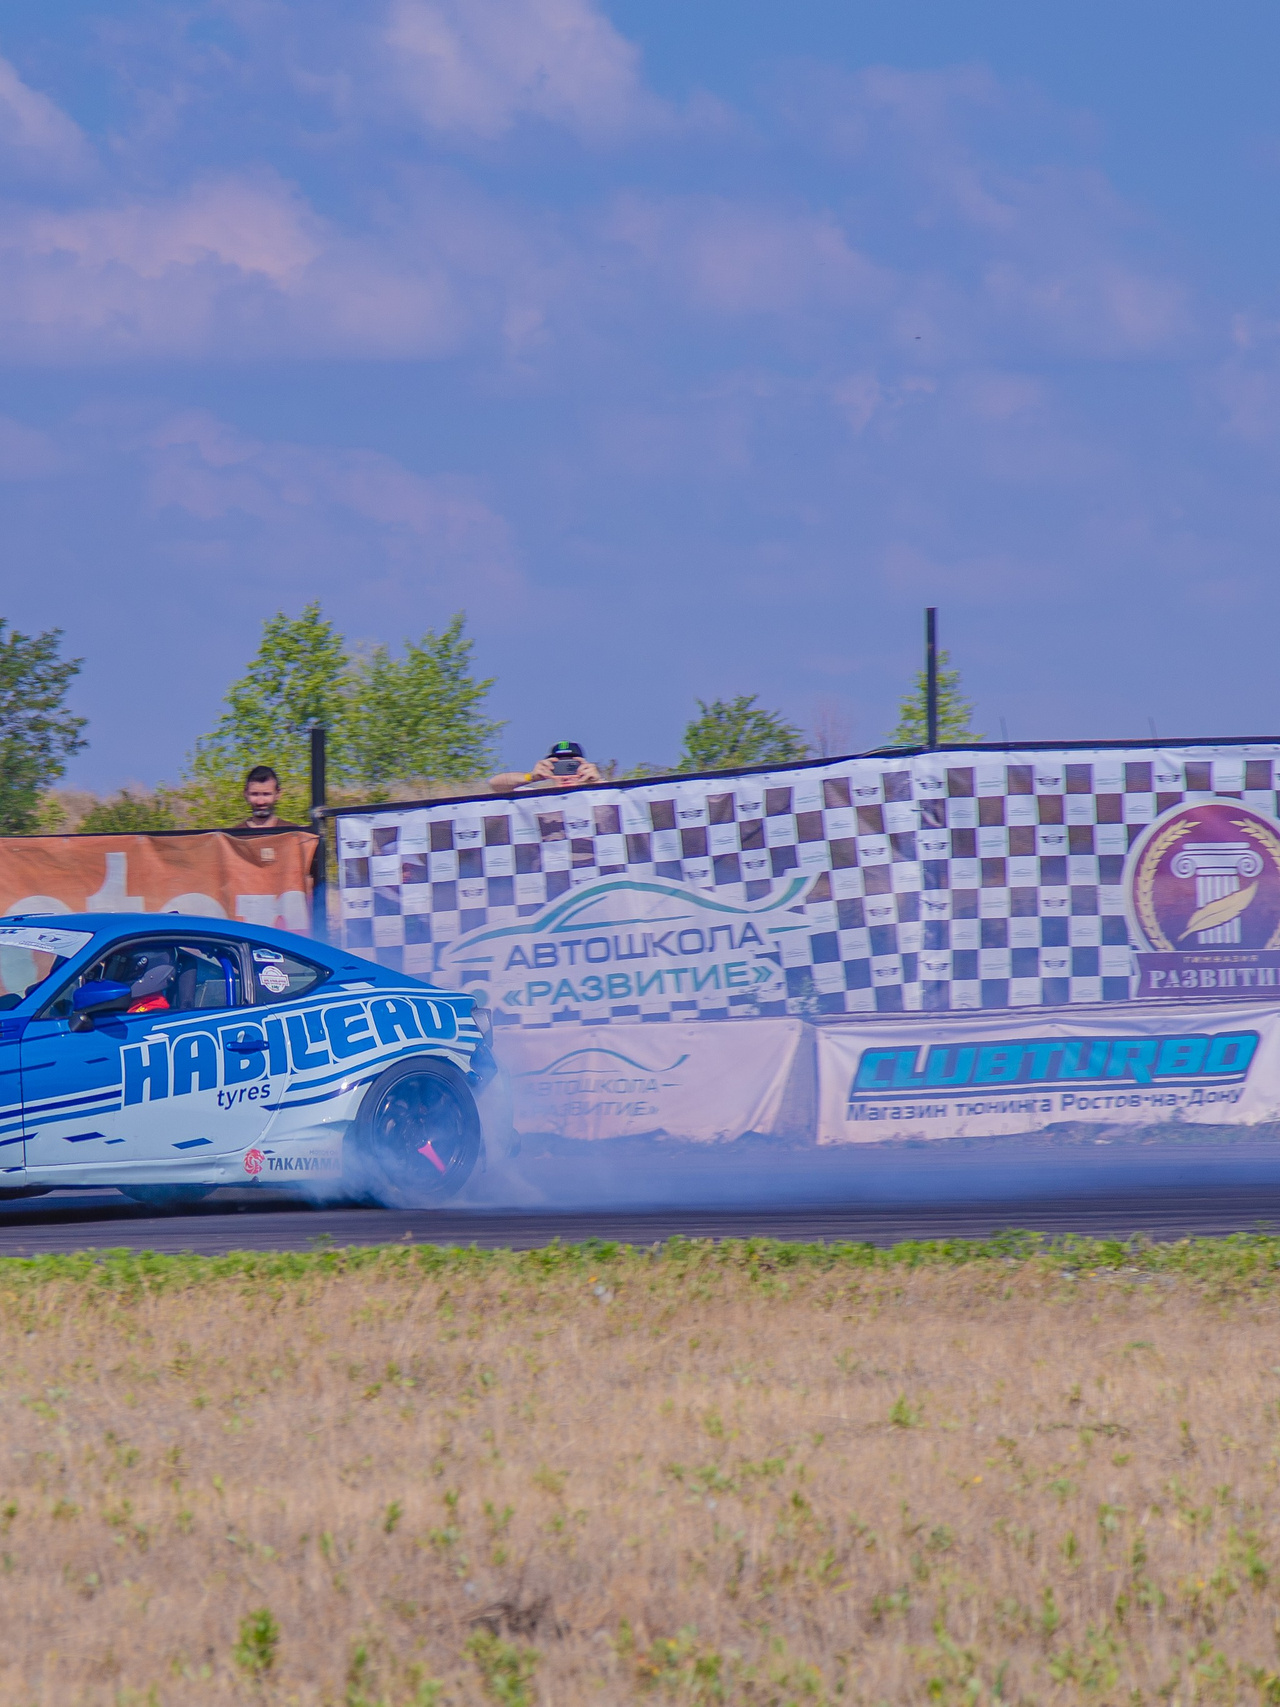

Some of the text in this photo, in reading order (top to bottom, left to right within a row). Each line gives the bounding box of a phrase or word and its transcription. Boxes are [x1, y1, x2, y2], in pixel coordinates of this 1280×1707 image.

[503, 922, 765, 971] АВТОШКОЛА
[501, 960, 774, 1006] «РАЗВИТИЕ»
[1147, 967, 1280, 989] РАЗВИТИ
[122, 998, 460, 1107] HABILEAD
[855, 1034, 1259, 1088] CLUBTURBO
[216, 1082, 271, 1111] tyres
[846, 1100, 948, 1122] Магазин
[956, 1096, 1052, 1118] тюнинга
[267, 1157, 341, 1171] TAKAYAMA
